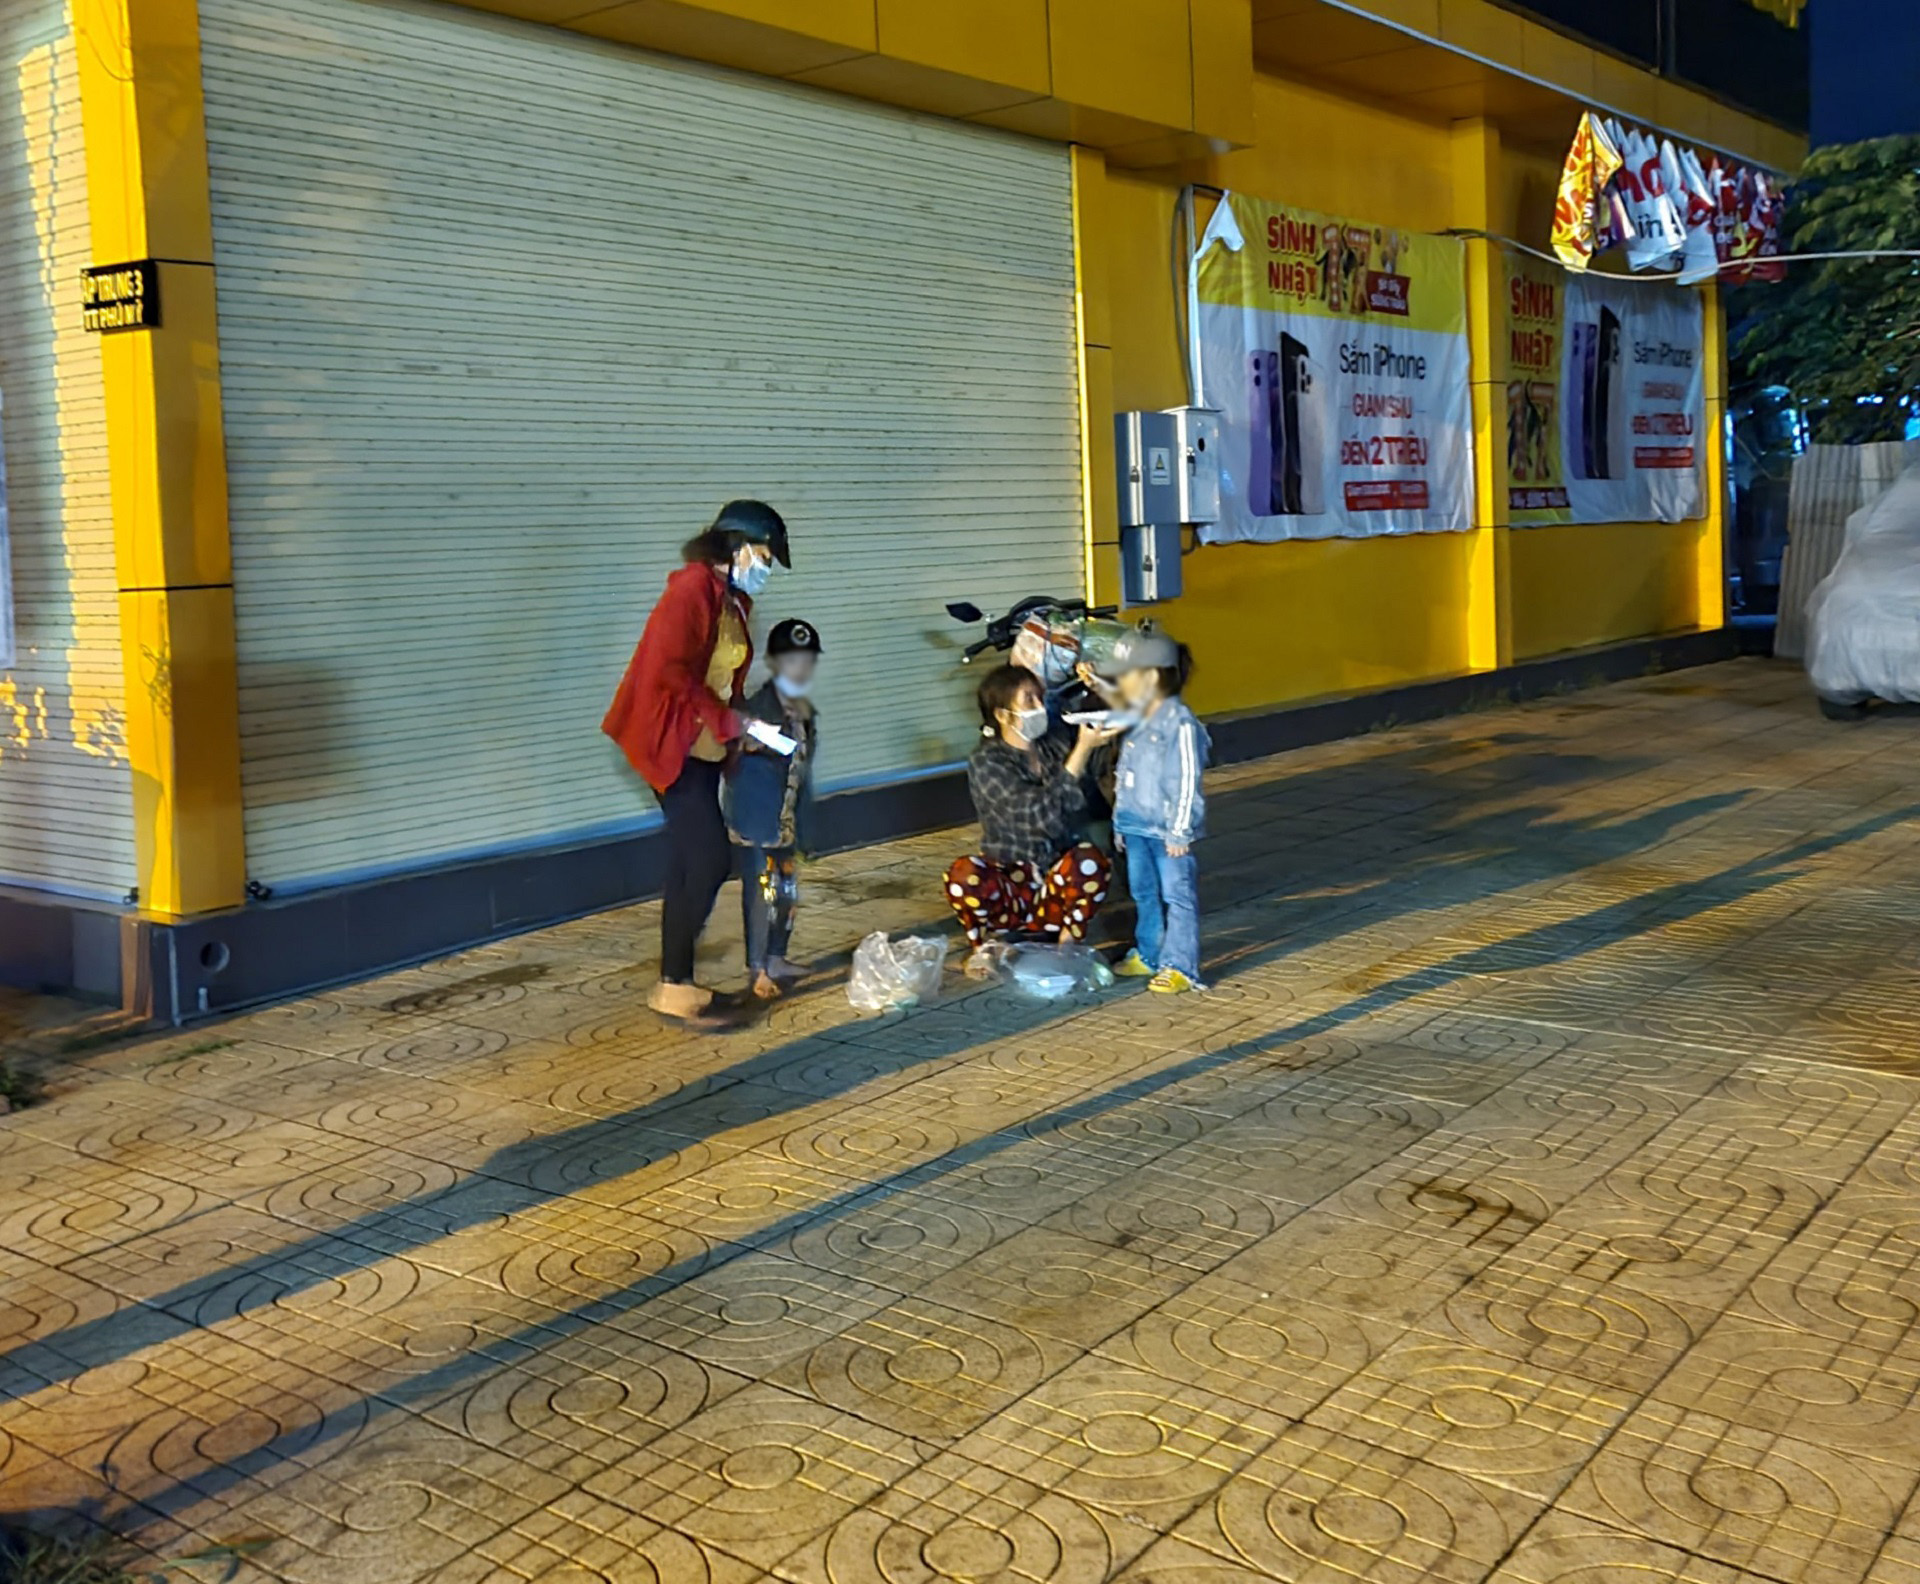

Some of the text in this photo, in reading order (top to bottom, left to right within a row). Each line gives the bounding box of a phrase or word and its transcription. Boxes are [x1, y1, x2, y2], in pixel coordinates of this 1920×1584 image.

[134, 269, 144, 296] 3
[1373, 343, 1426, 380] iPhone
[1369, 436, 1384, 465] 2
